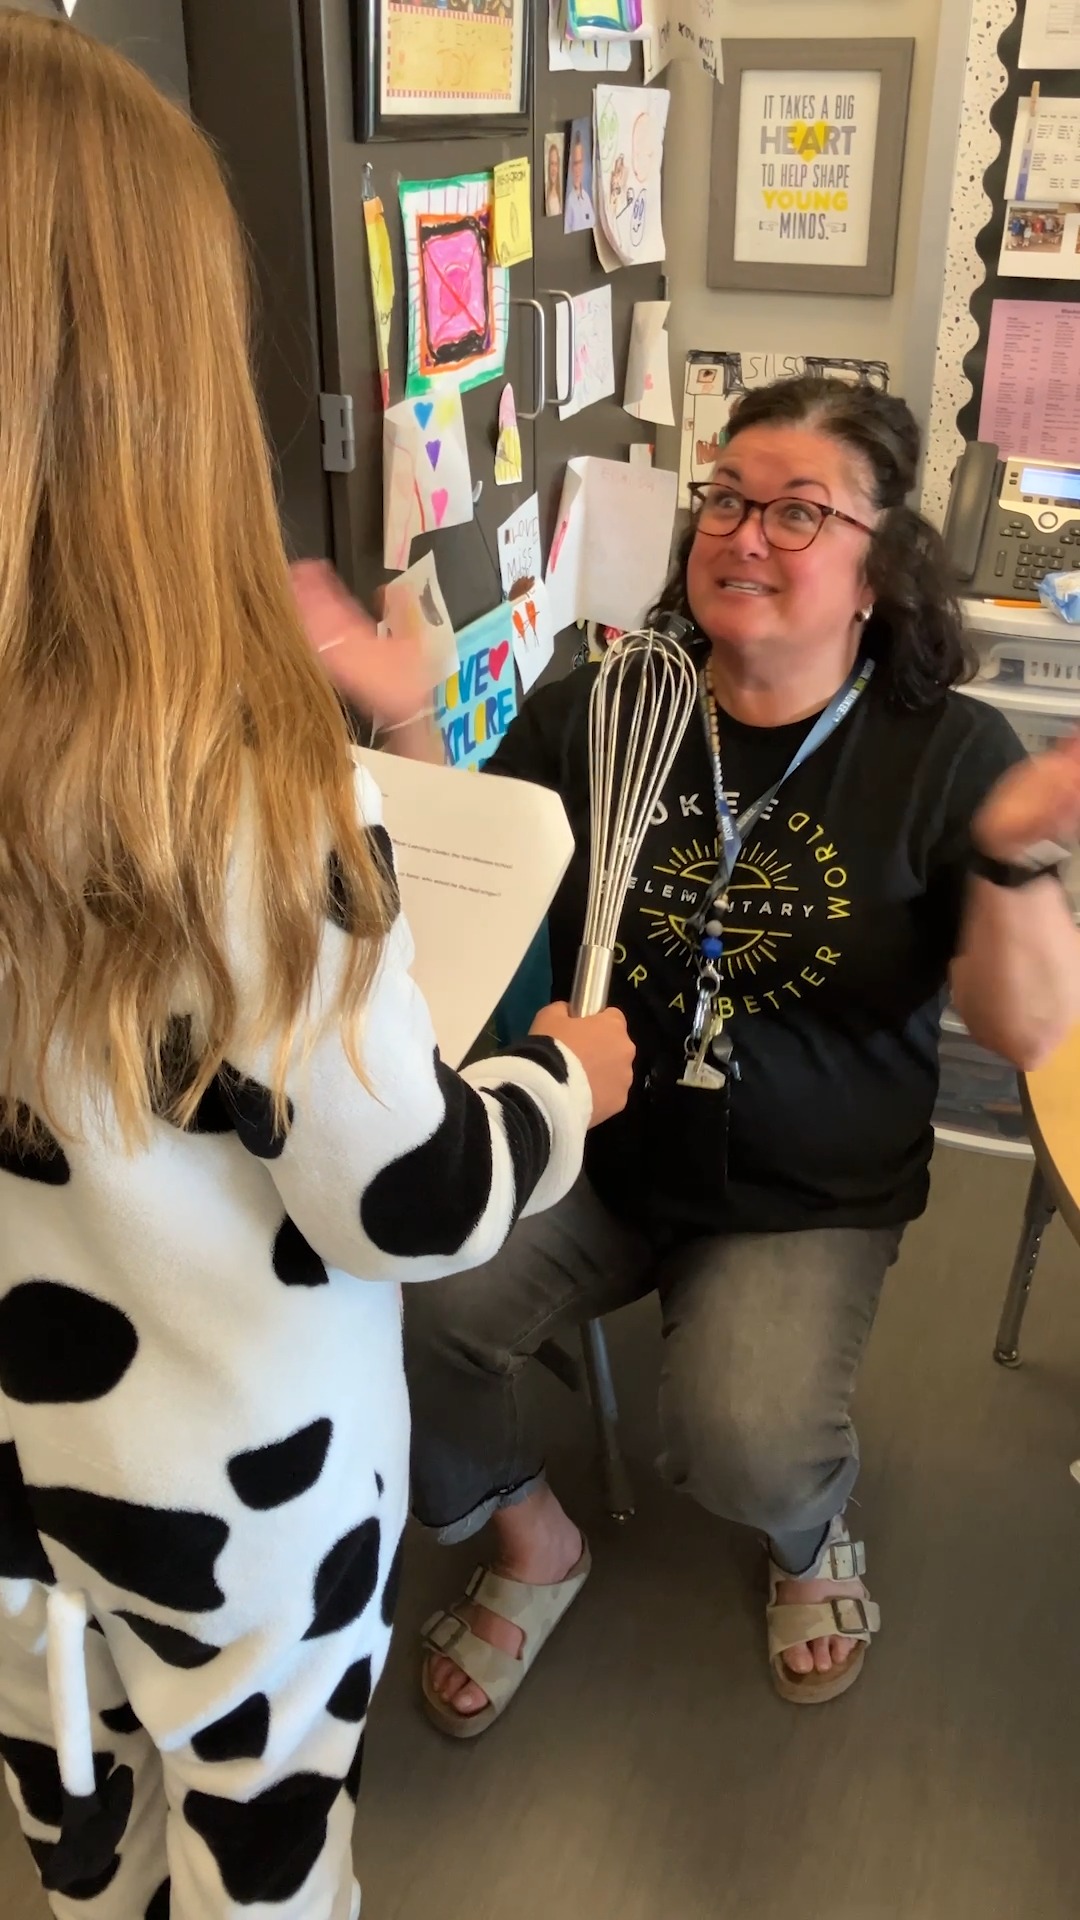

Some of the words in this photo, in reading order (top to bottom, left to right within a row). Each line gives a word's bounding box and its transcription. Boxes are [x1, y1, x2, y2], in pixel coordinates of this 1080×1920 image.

[763, 94, 775, 120] IT
[780, 94, 816, 120] TAKES
[820, 94, 829, 120] A
[835, 94, 856, 120] BIG
[760, 125, 857, 155] HEART
[761, 163, 775, 187] TO
[780, 163, 808, 188] HELP
[812, 164, 850, 189] SHAPE
[761, 190, 849, 212] YOUNG
[779, 212, 830, 240] MINDS.
[433, 647, 490, 721] LOVE
[441, 687, 513, 767] XPLORE
[627, 876, 815, 919] ELEMTARY
[668, 992, 686, 1015] A
[717, 944, 843, 1020] BETTER
[787, 811, 852, 920] WORLD
